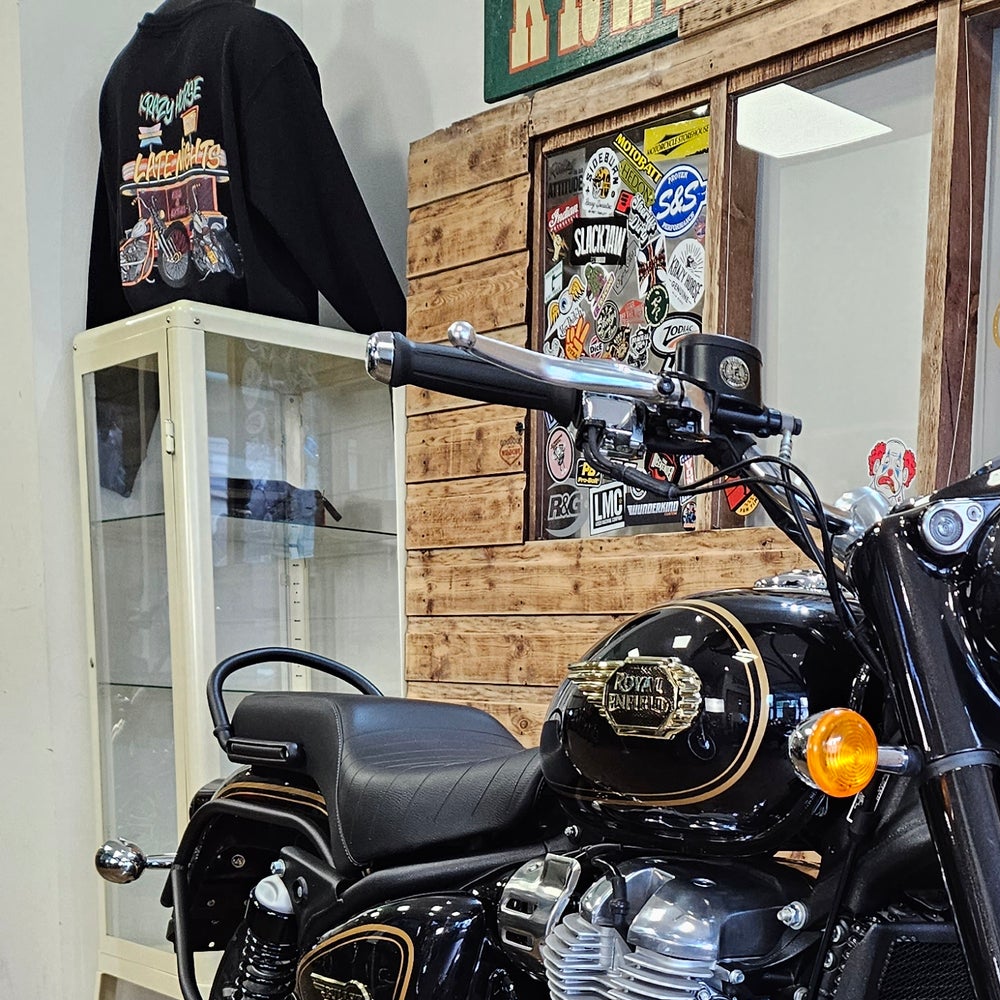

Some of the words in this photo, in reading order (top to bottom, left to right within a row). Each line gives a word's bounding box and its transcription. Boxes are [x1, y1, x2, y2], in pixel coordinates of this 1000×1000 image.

[138, 91, 175, 126] KRAZY
[133, 150, 173, 184] LATE
[175, 137, 221, 174] NIGHTS
[585, 151, 619, 185] SIDEBURN
[548, 203, 579, 228] Indian
[656, 179, 701, 220] S&S
[573, 224, 627, 258] SLACKJAW
[663, 324, 696, 347] ZODIAC
[547, 490, 582, 521] R&G
[594, 487, 623, 520] LMC
[613, 672, 665, 694] ROYAL
[608, 693, 675, 713] ENFIELD
